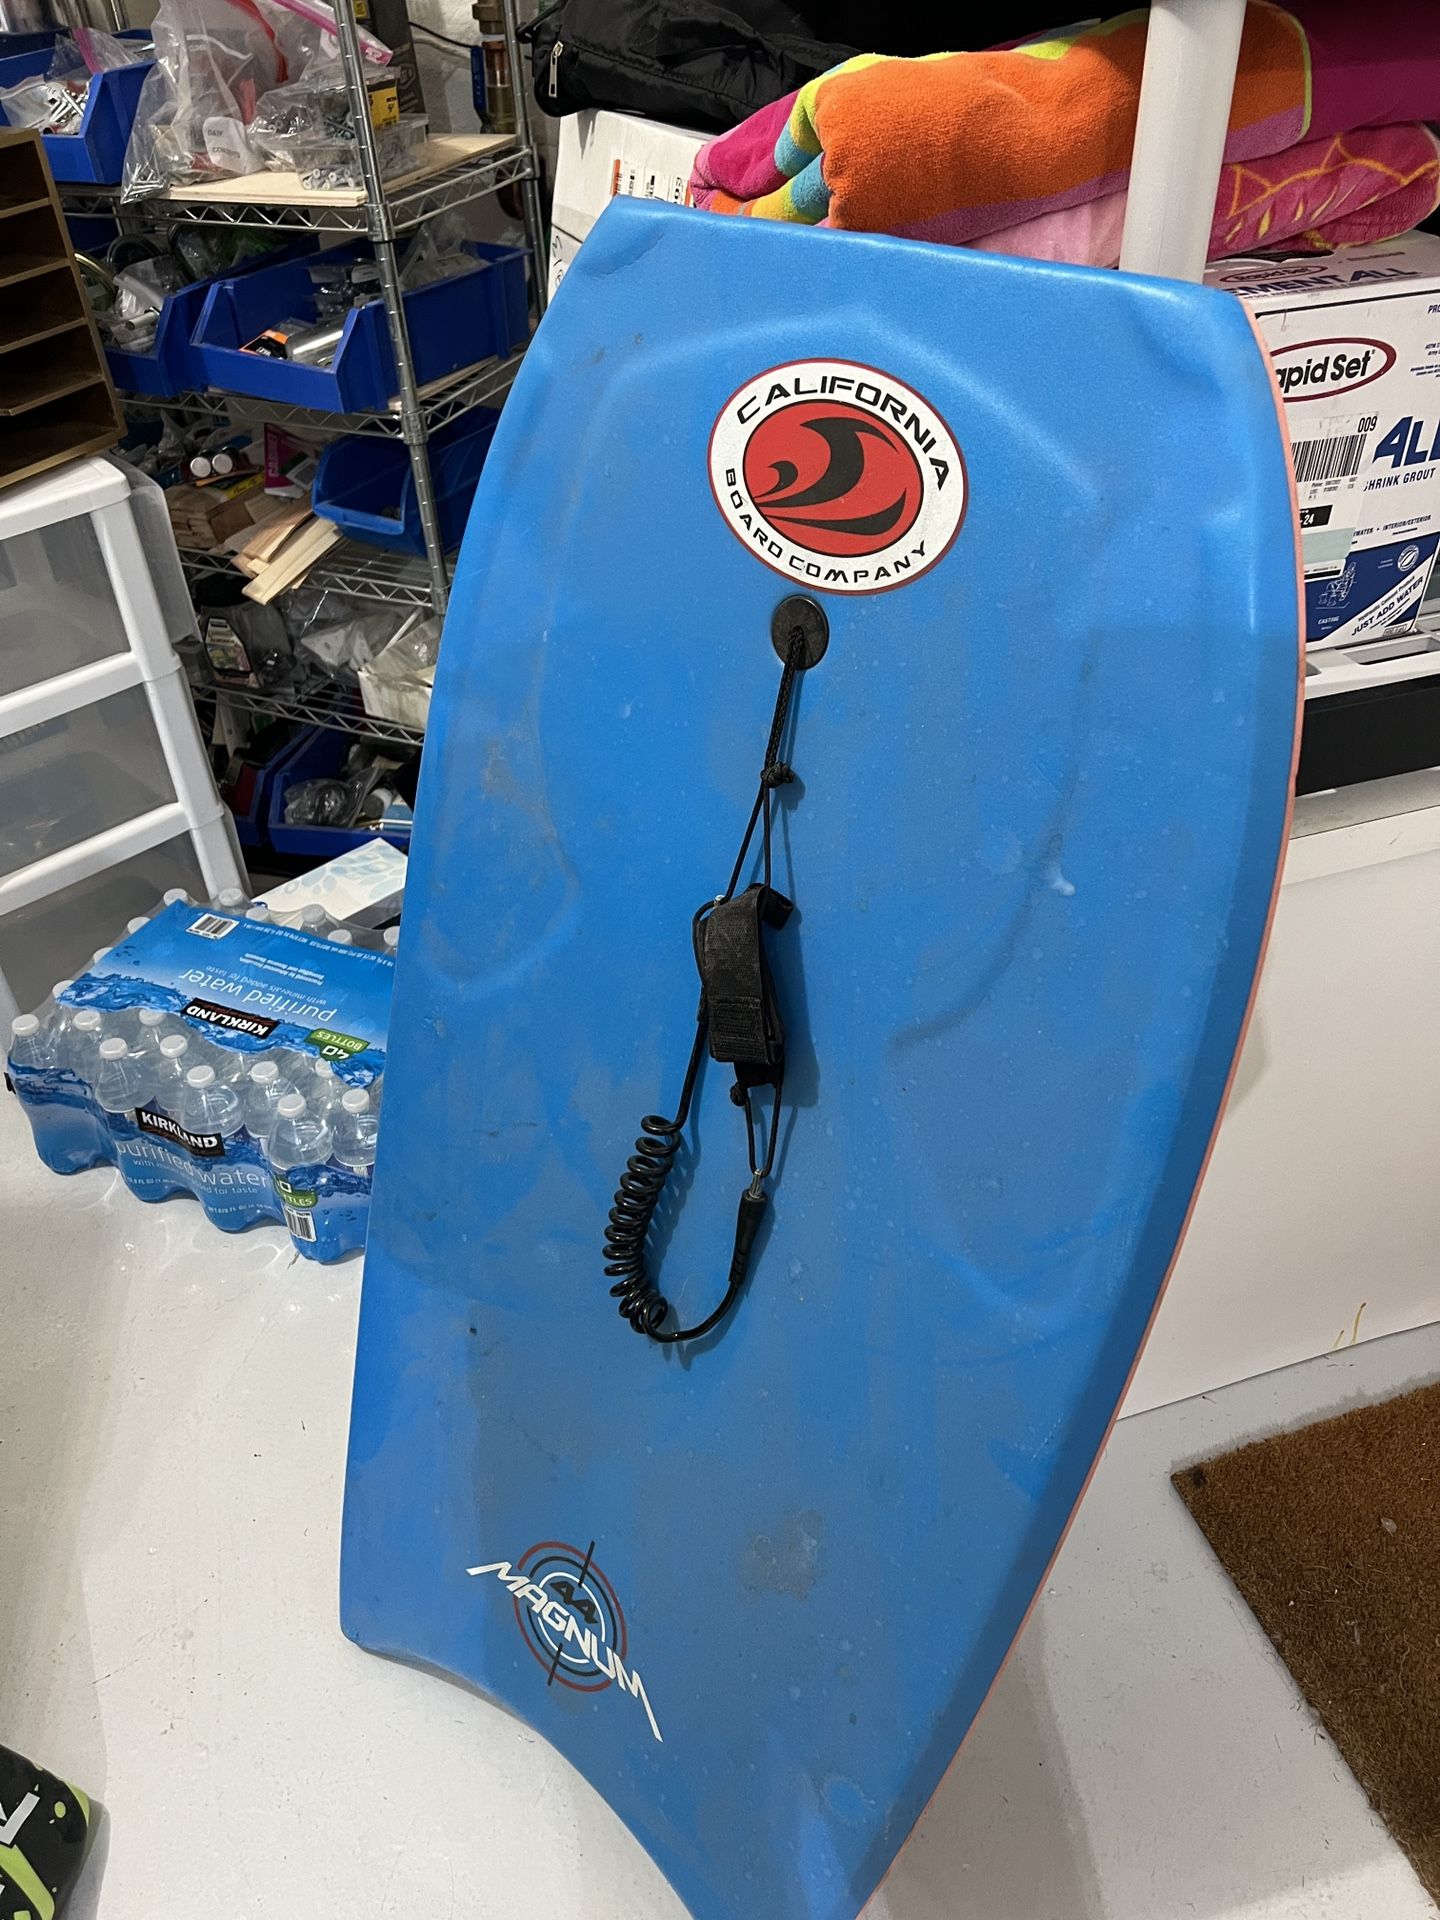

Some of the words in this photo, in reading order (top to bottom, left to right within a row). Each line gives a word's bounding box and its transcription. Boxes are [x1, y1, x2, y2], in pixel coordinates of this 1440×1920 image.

[1350, 267, 1419, 282] ALL
[1275, 355, 1330, 394] apid
[1330, 350, 1371, 381] Set
[736, 375, 950, 492] CALIFORNIA
[1357, 416, 1378, 433] 009
[1403, 467, 1437, 484] GROUT
[725, 467, 783, 559] BOARD
[788, 539, 927, 584] COMPANY
[1351, 615, 1375, 636] JUST
[1376, 601, 1395, 620] ADD
[1396, 575, 1424, 604] WATER
[178, 968, 242, 997] water
[185, 1004, 269, 1037] KIRKLAND
[242, 988, 338, 1023] purified
[315, 1031, 363, 1051] BOTTLES
[321, 1045, 350, 1060] 40
[140, 1111, 219, 1149] KIRKLAND
[114, 1140, 194, 1177] purified
[199, 1168, 270, 1188] water
[465, 1561, 664, 1743] MAGNUM
